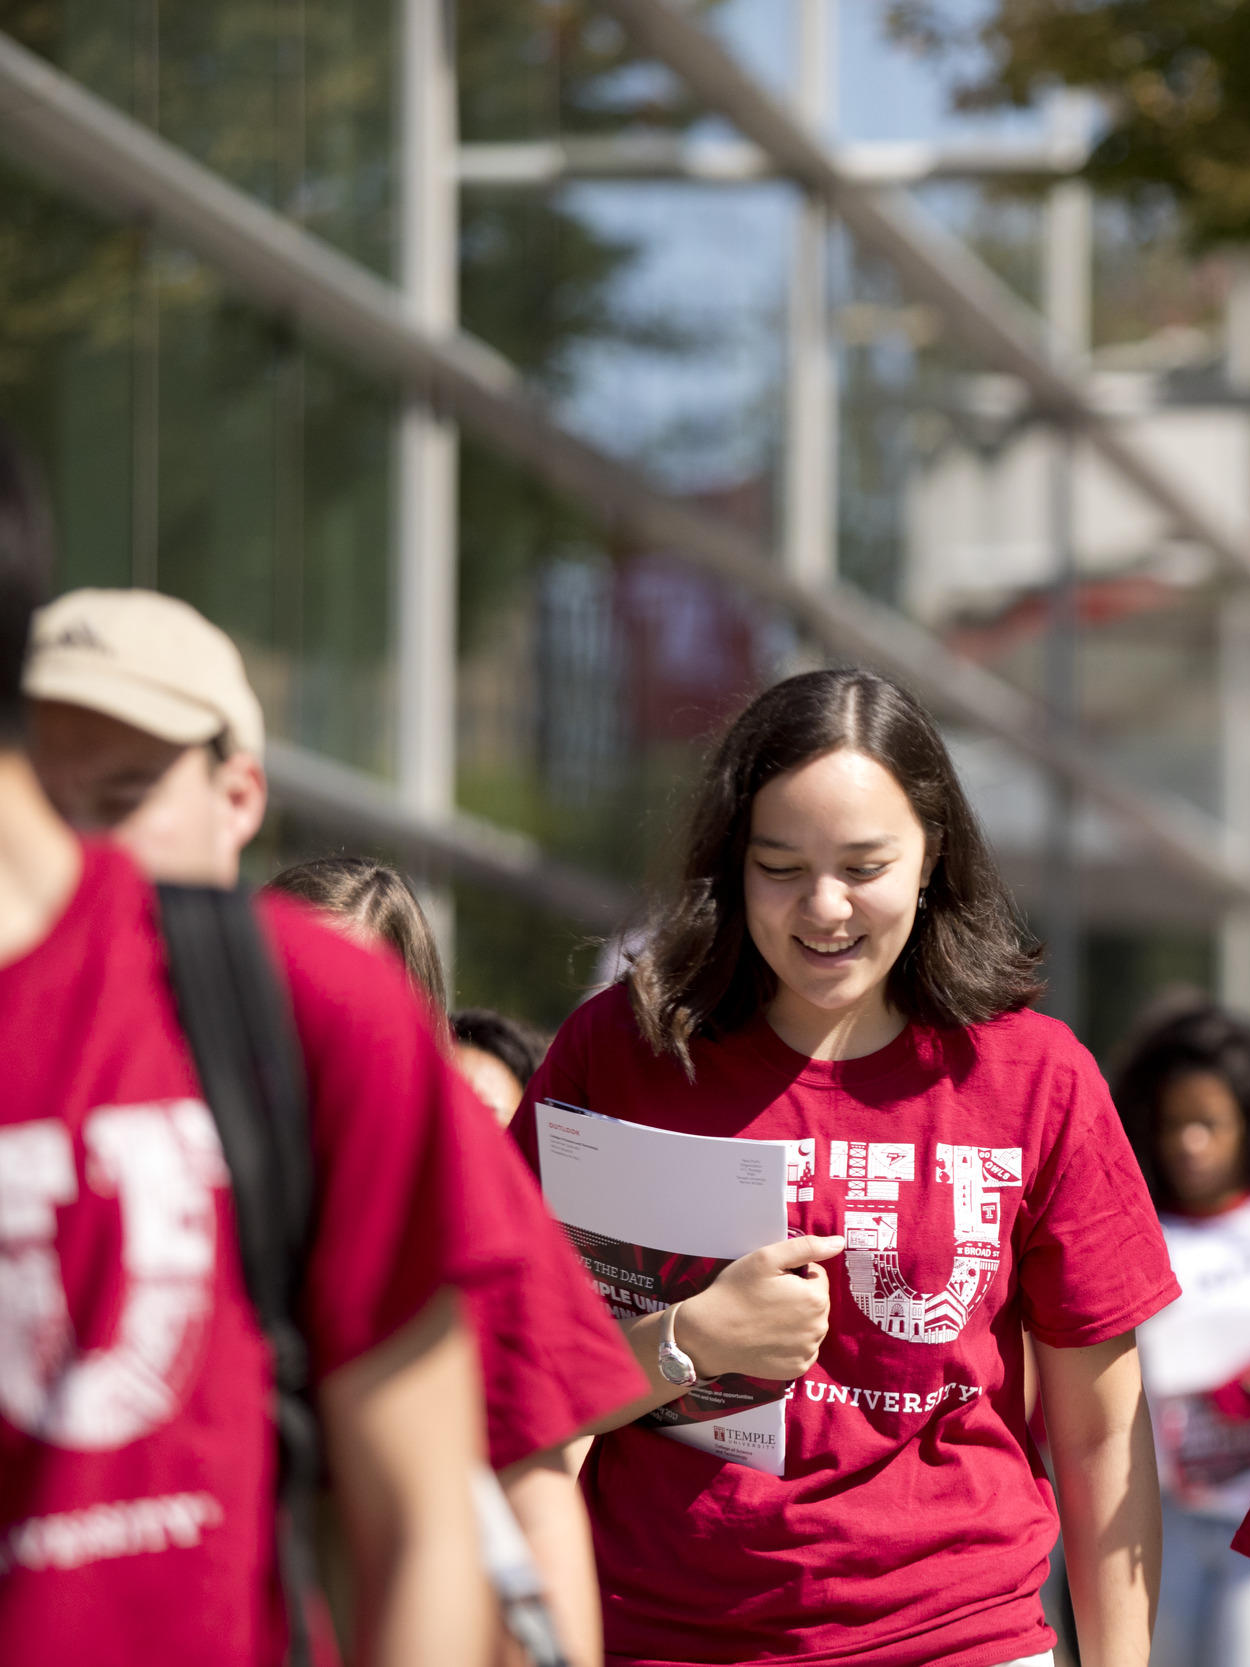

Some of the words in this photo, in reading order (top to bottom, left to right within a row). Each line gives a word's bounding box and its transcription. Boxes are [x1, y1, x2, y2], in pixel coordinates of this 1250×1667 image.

[984, 1161, 1011, 1181] OWLS
[963, 1247, 991, 1258] BROAD
[594, 1260, 619, 1279] THE
[620, 1269, 655, 1289] DATE
[726, 1428, 776, 1445] TEMPLE
[728, 1440, 775, 1450] UNIVERSITY
